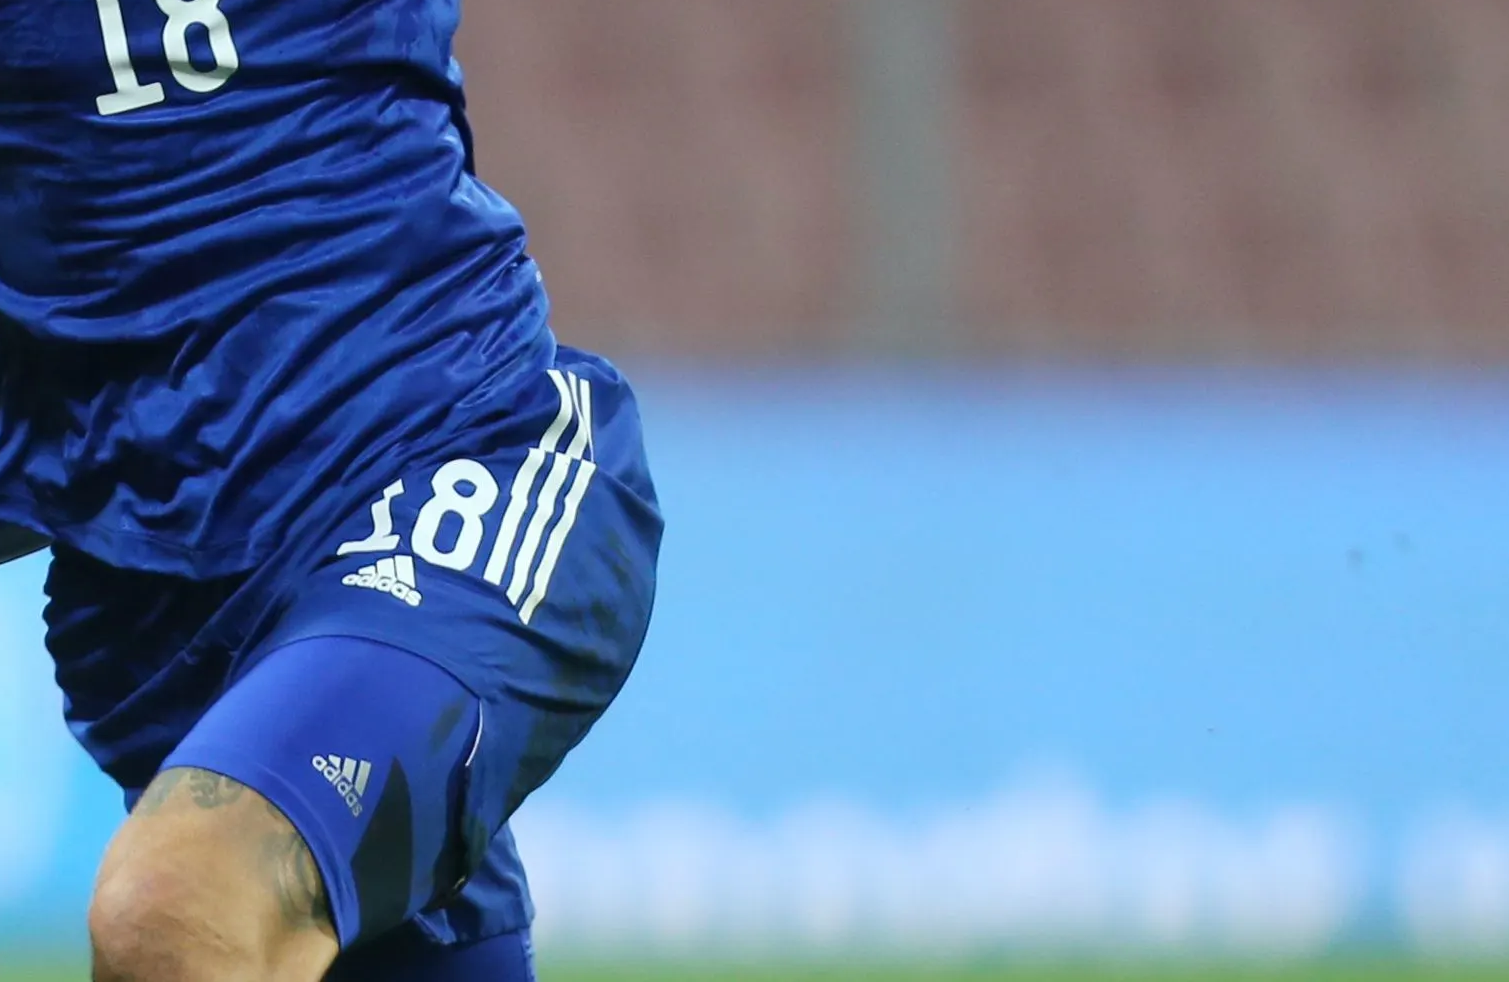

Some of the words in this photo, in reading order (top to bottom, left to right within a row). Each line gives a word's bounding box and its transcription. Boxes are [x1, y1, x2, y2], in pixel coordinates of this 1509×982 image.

[337, 458, 499, 571] 18
[342, 572, 422, 607] adidas
[312, 755, 363, 817] adidas
